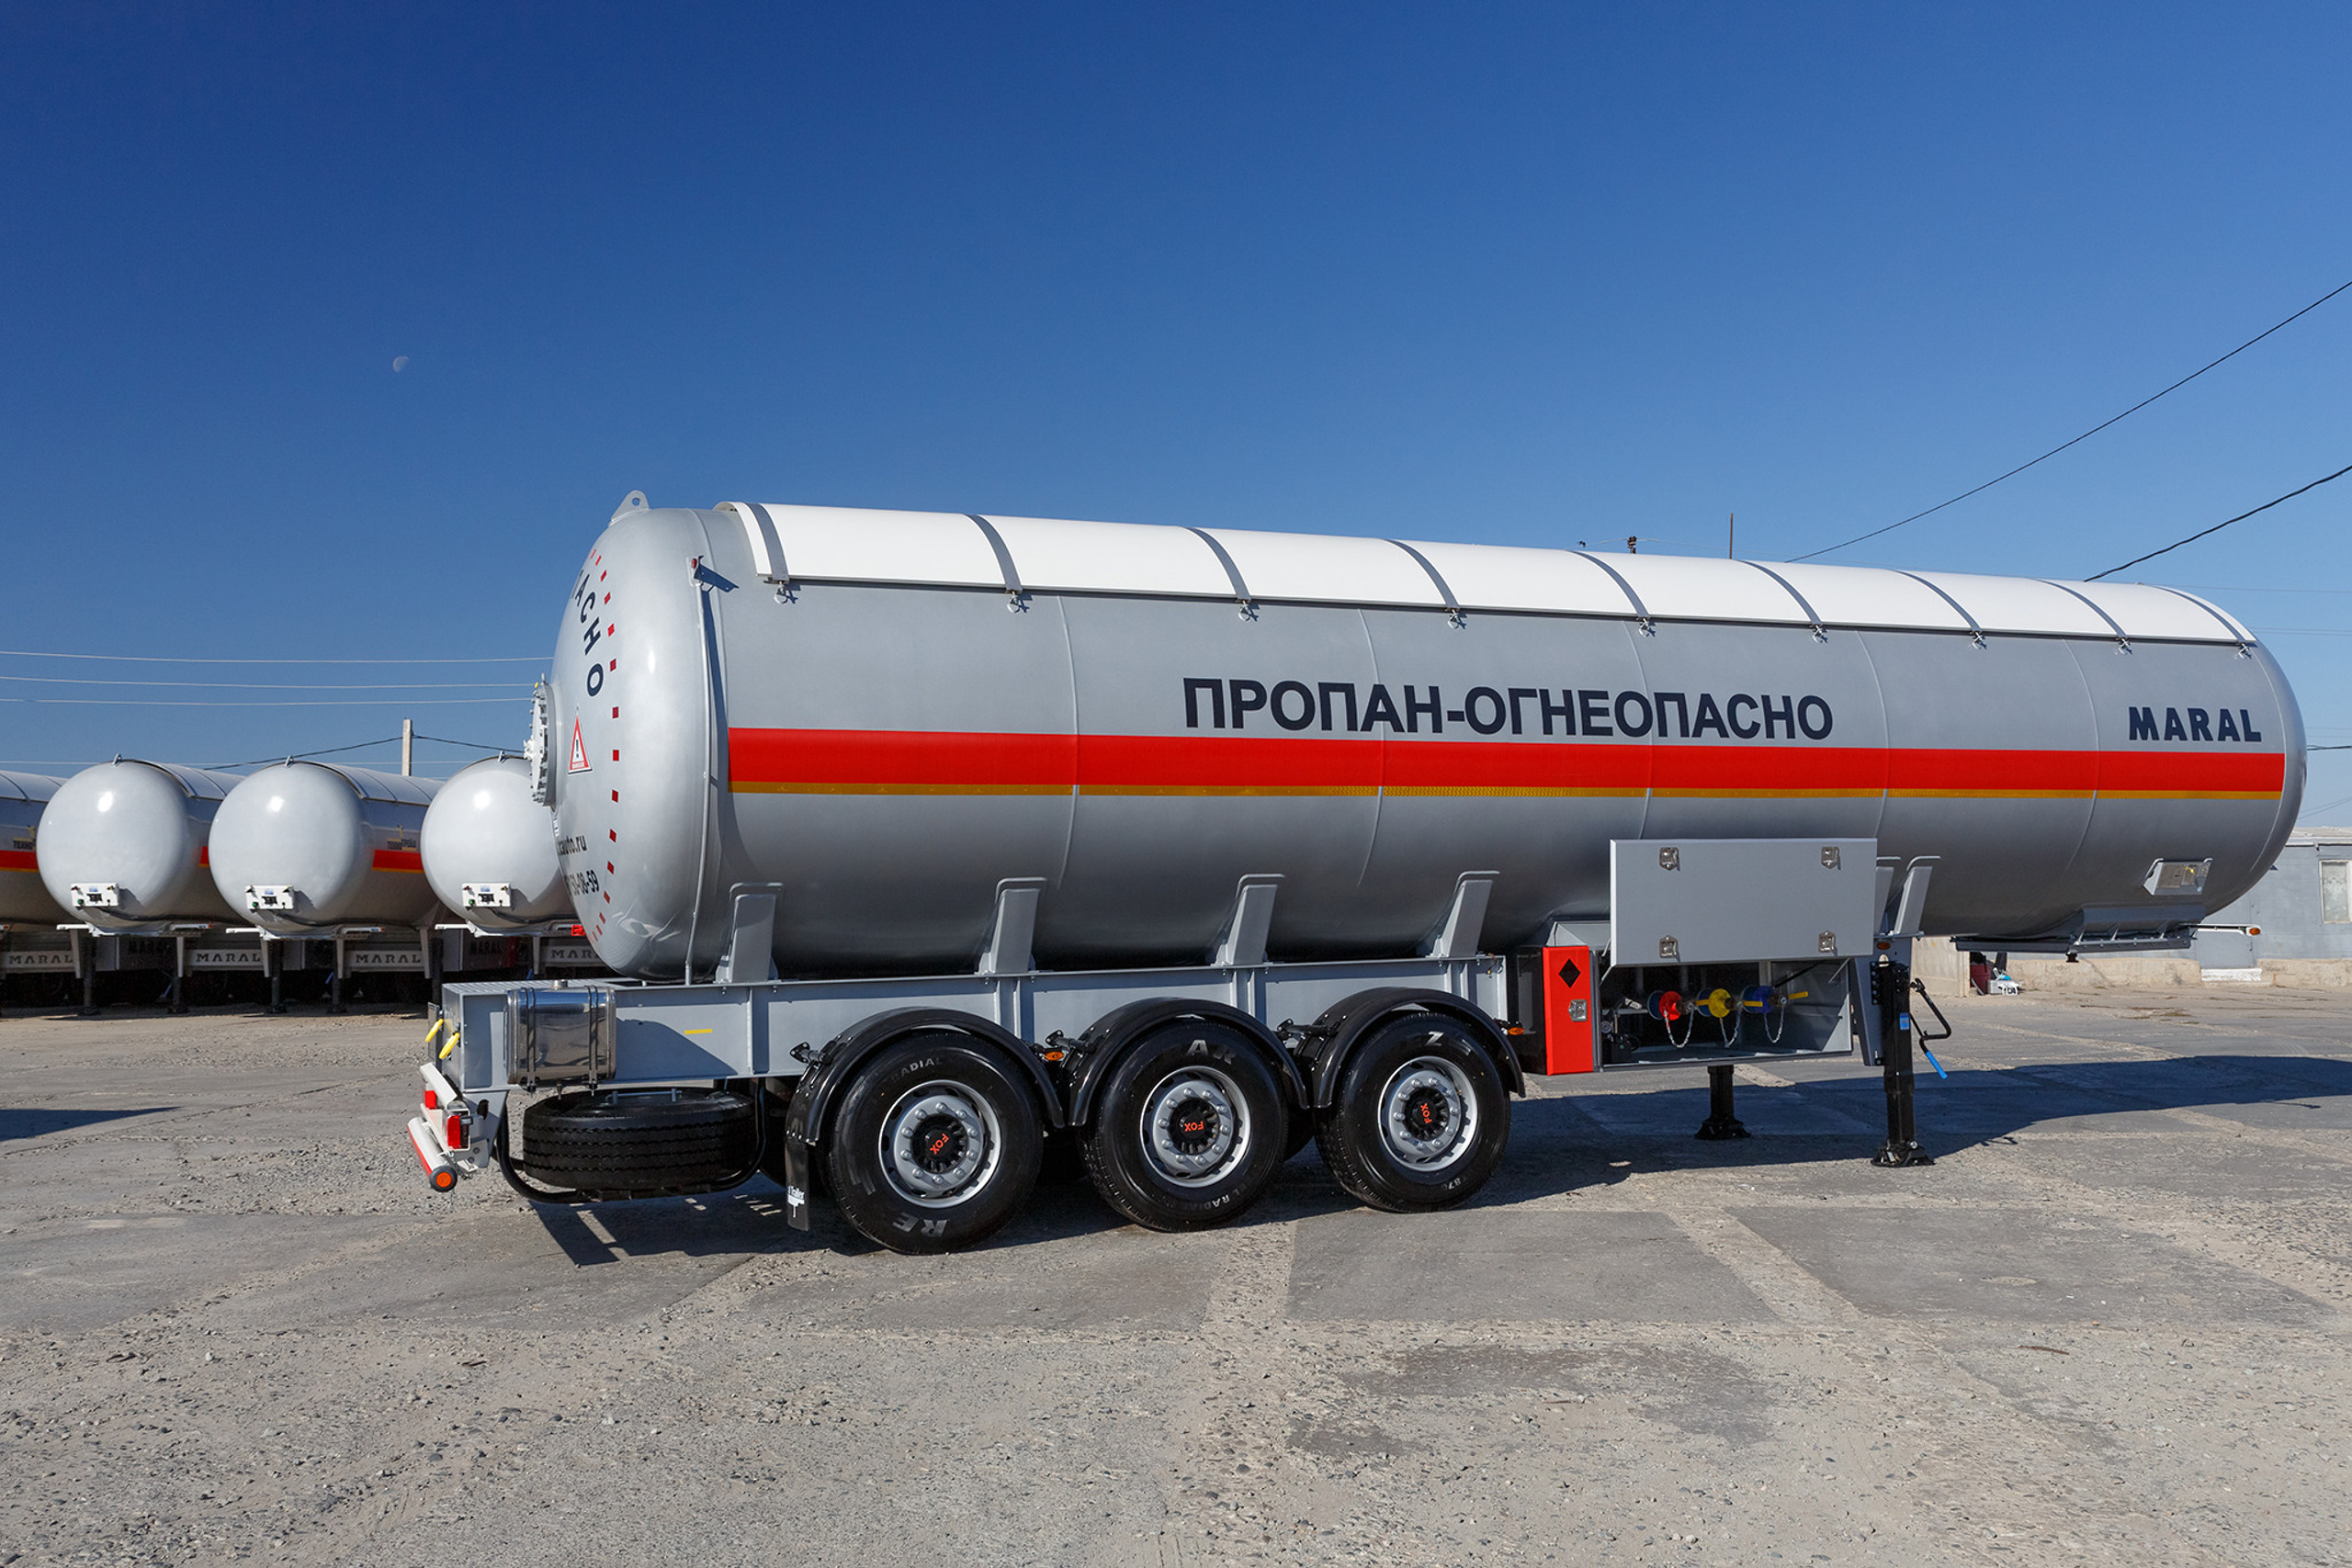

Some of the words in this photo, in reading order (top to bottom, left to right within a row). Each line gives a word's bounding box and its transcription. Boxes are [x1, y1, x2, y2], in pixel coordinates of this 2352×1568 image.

[1183, 677, 1834, 740] ПРОПАН-ОГНЕОПАСНО
[2128, 706, 2262, 742] MARAL
[8, 954, 74, 964] MARAL
[196, 953, 261, 963] MARAL
[356, 953, 421, 964] MARAL
[551, 949, 599, 959] MAR
[1420, 1102, 1432, 1124] FOX
[1184, 1121, 1204, 1132] FOX
[929, 1133, 949, 1155] FOX
